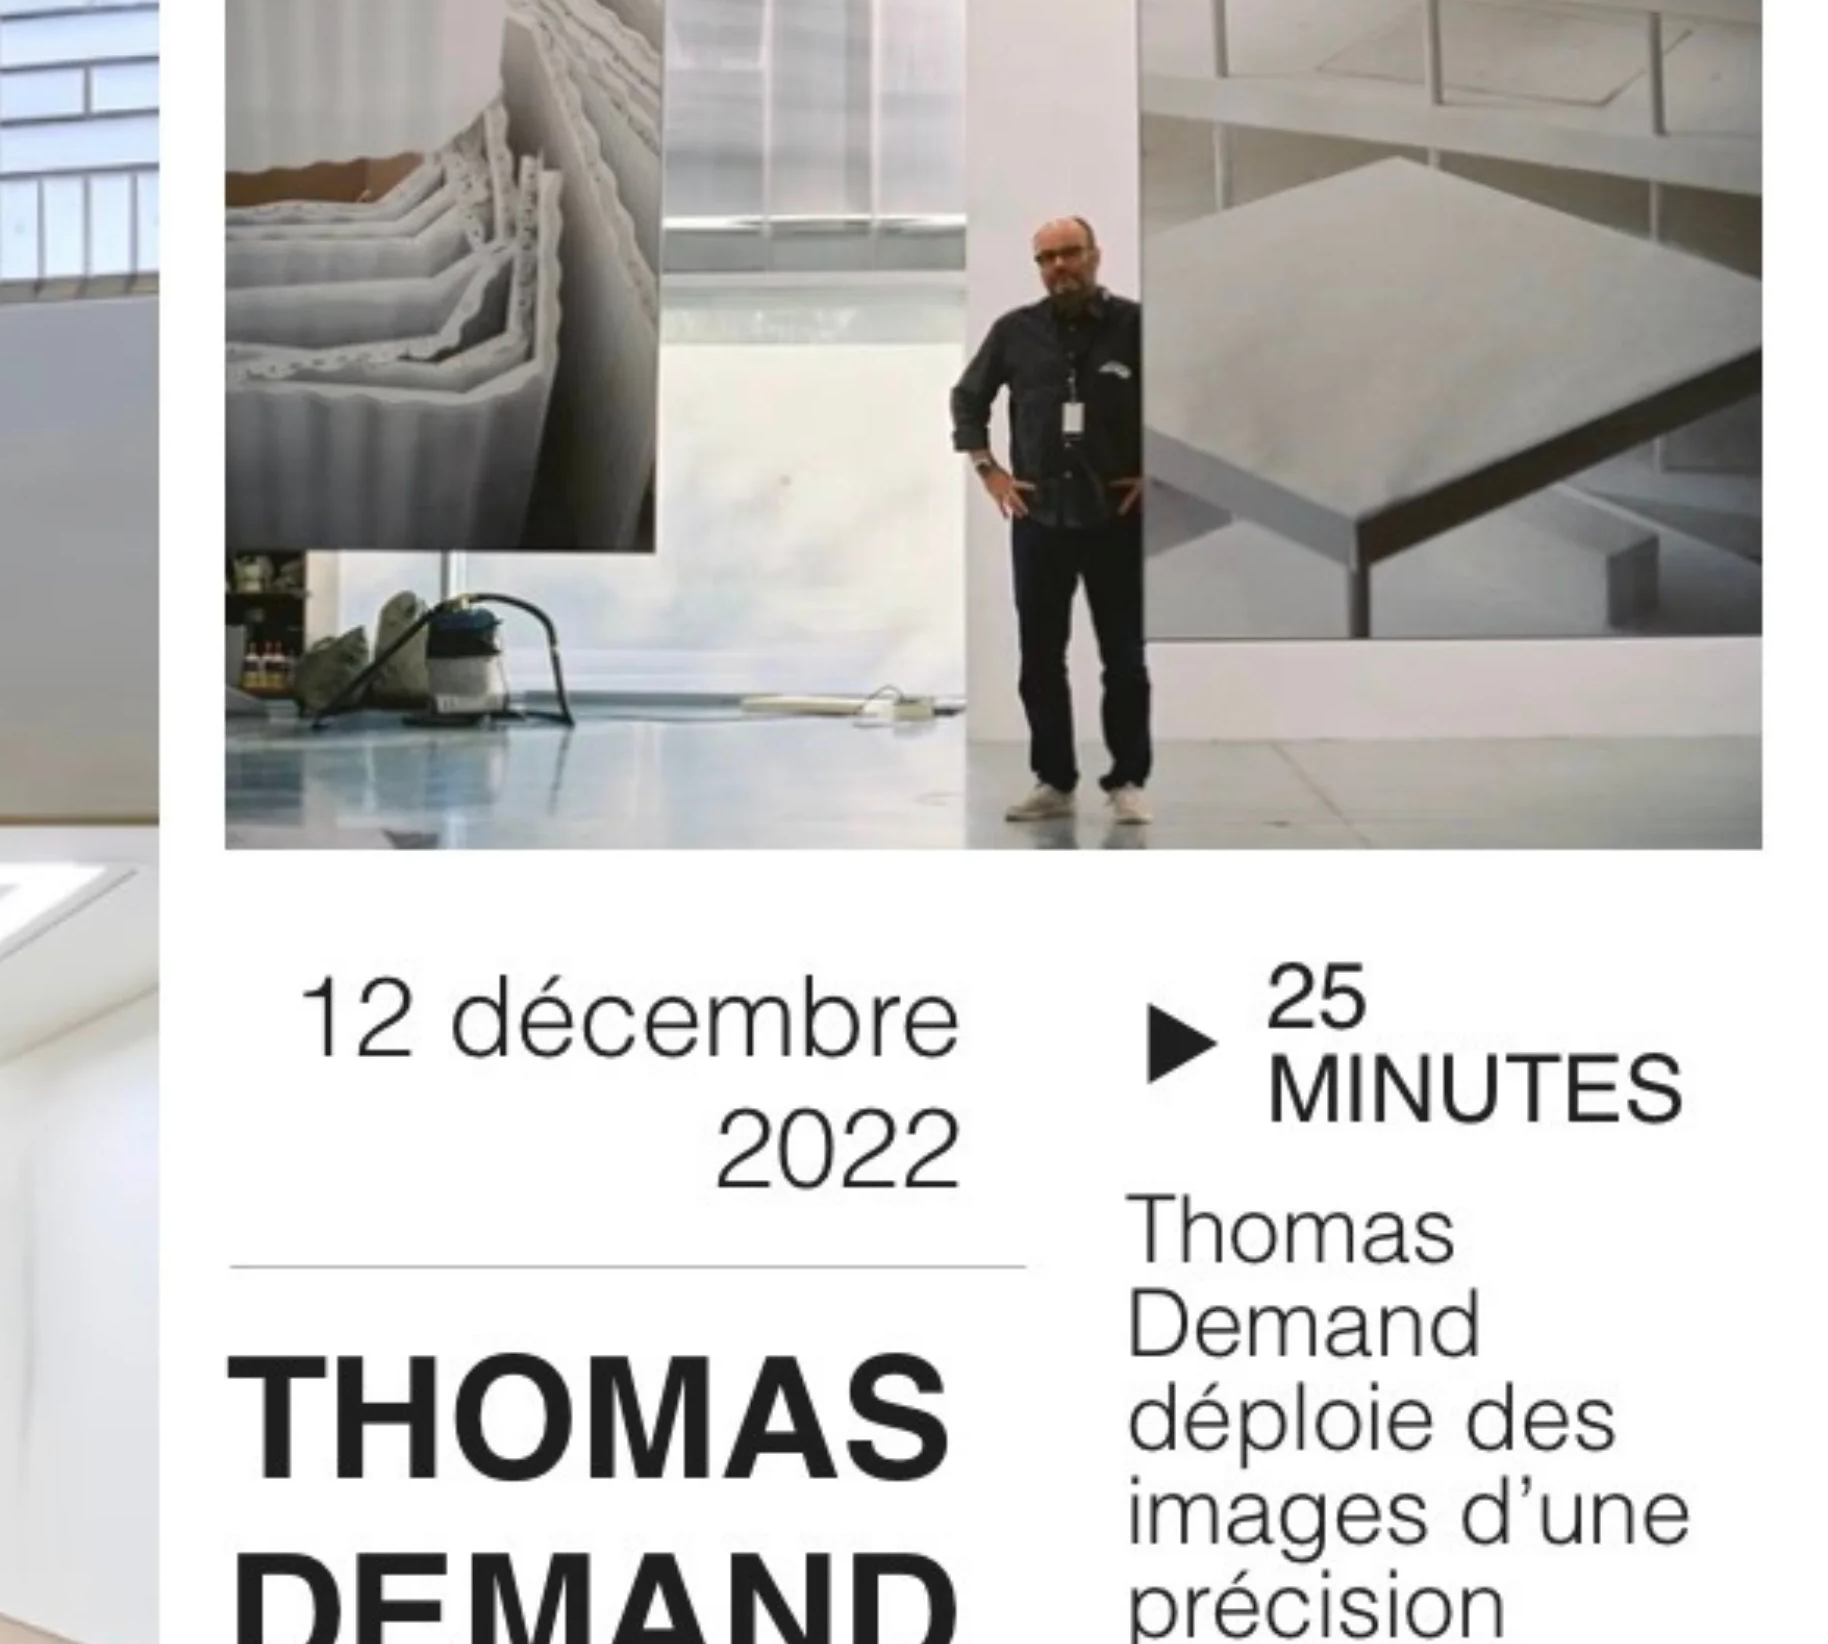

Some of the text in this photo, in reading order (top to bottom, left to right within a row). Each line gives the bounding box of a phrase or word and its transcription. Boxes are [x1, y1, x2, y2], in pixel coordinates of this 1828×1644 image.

[302, 974, 959, 1060] 12 décembre
[1268, 961, 1366, 1031] 25
[1271, 1052, 1682, 1125] MINUTES
[717, 1106, 960, 1191] 2022
[1124, 1193, 1454, 1265] Thomas
[1131, 1287, 1479, 1359] Demand
[227, 1352, 948, 1482] THOMAS
[1129, 1380, 1616, 1470] déploie des
[1130, 1474, 1428, 1565] images
